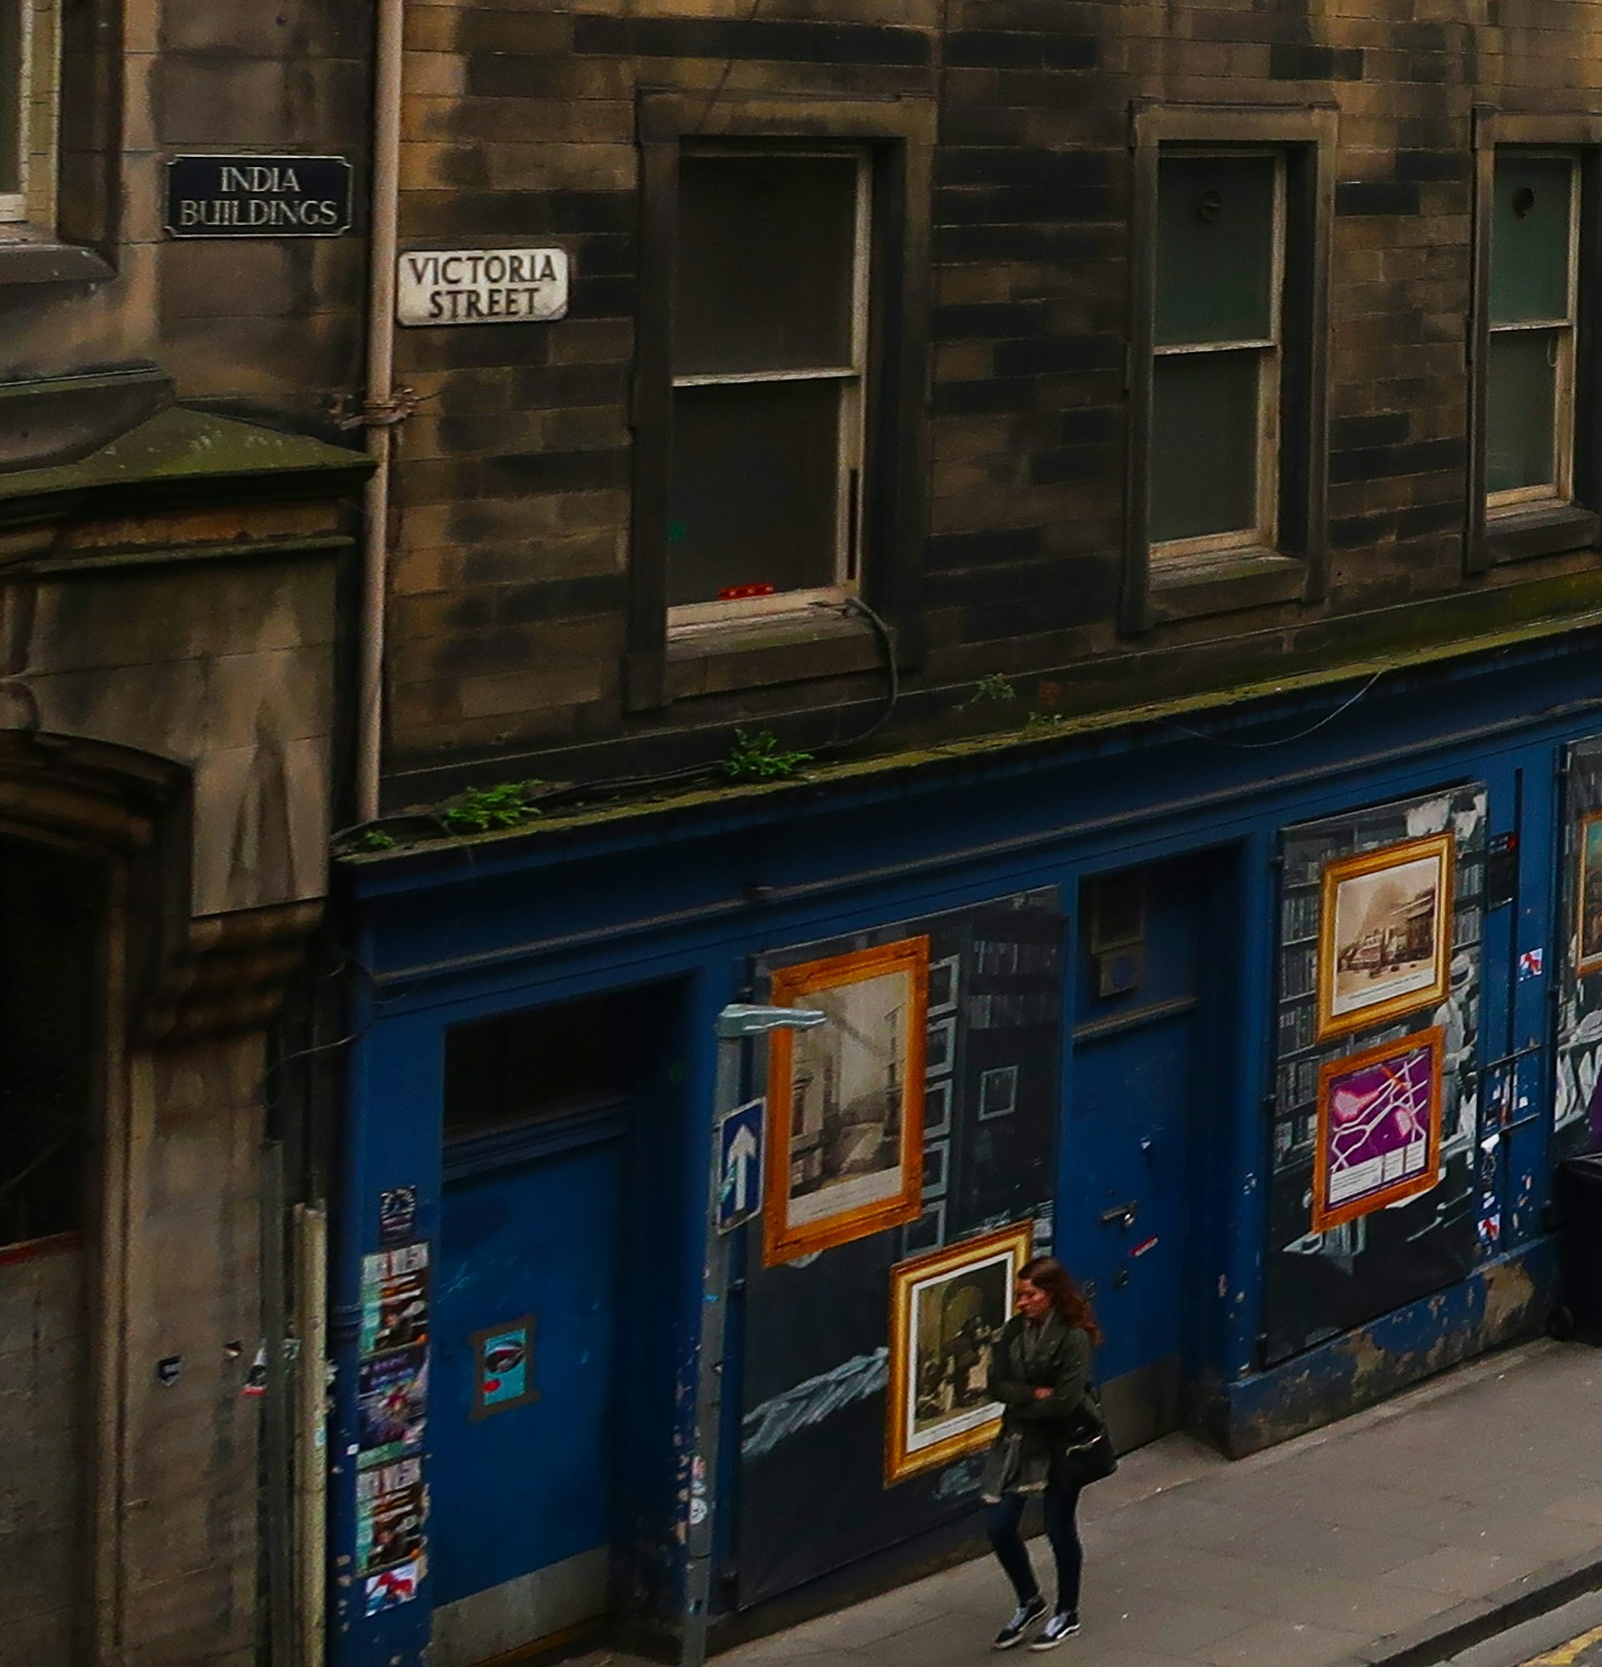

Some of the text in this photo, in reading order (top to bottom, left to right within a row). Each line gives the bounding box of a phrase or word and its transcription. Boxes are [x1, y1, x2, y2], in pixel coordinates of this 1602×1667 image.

[220, 166, 302, 193] INDIA
[180, 199, 339, 227] BUILDINGS
[407, 255, 558, 286] VICTORIA
[429, 287, 540, 319] STREET
